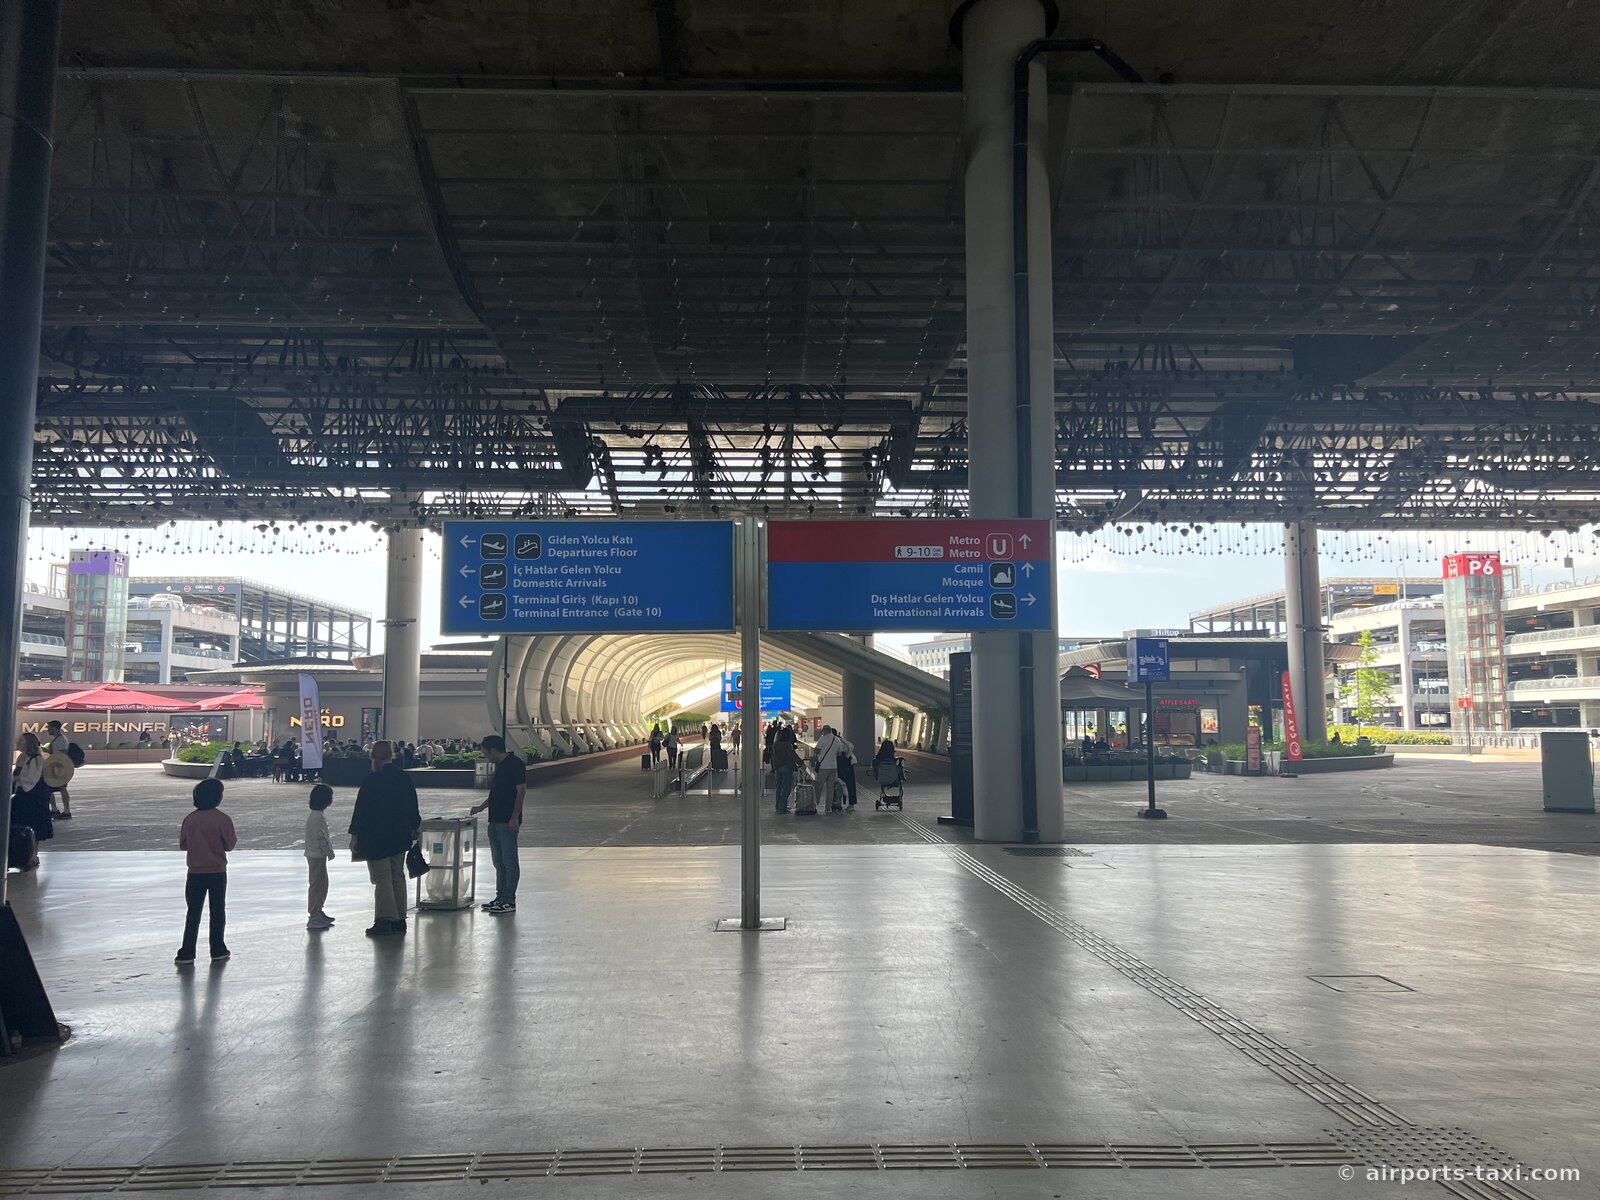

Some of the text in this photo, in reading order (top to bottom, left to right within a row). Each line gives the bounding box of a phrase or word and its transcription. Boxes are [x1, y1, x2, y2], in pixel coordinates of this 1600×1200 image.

[548, 535, 633, 544] Giden Yolcu Katı
[949, 536, 980, 545] Metro
[548, 548, 637, 559] Departures Floor
[906, 547, 930, 557] 9-10
[949, 549, 980, 558] Metro
[513, 564, 621, 576] İç Hatlar Gelen Yolcu
[954, 564, 983, 574] Camii
[1469, 560, 1494, 575] P6
[513, 578, 607, 588] Domestic Arrivals
[942, 577, 983, 588] Mosque
[513, 595, 638, 606] Terminal Giriş (Kapı 10)
[871, 594, 983, 606] Dış Hatlar Gelen Yolcu
[513, 607, 662, 618] Terminal Entrance (Gate 10)
[873, 607, 984, 617] International Arrivals
[290, 715, 344, 728] NRO
[73, 722, 167, 733] BRENNER
